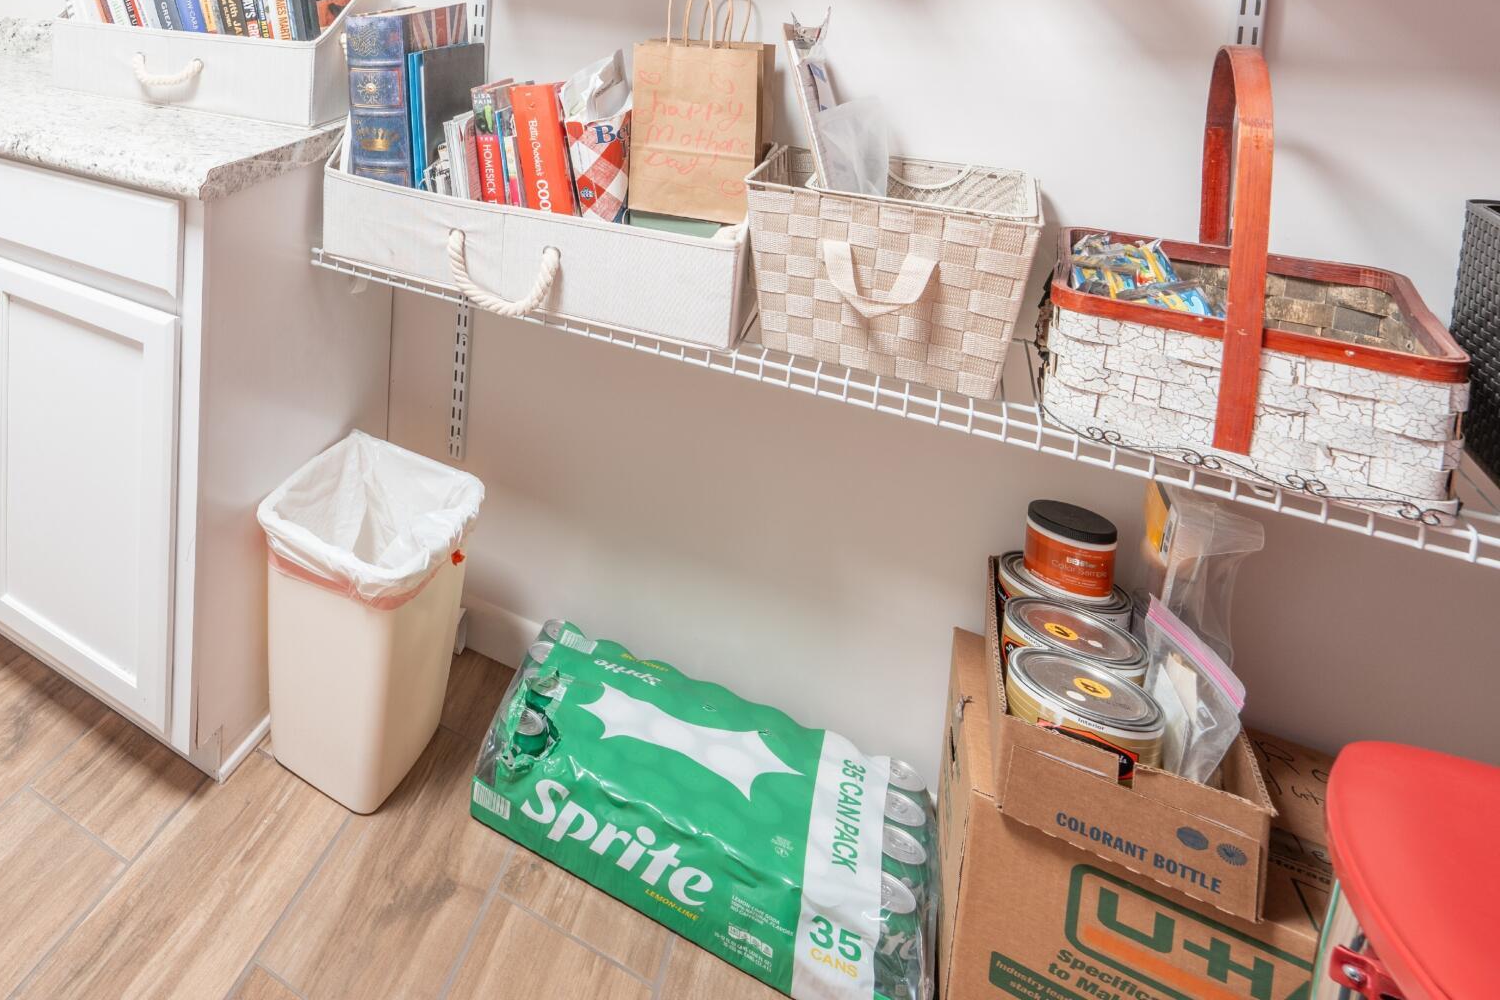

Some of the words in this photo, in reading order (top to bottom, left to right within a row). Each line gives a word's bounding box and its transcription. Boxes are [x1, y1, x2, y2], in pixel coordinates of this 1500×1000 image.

[160, 1, 174, 31] GREAT
[483, 144, 497, 195] HOMESICK
[528, 119, 538, 141] Betty
[536, 179, 552, 213] COO
[1051, 559, 1076, 573] Color
[1077, 568, 1108, 578] Sample
[1077, 717, 1105, 732] Interior
[840, 758, 867, 782] 35
[833, 781, 864, 827] CAN
[520, 778, 714, 906] Sprite
[830, 819, 861, 875] PACK
[1056, 812, 1149, 862] COLORANT
[1153, 853, 1223, 894] BOTTLE
[645, 888, 699, 922] LEMON-LIME
[808, 914, 863, 964] 35
[809, 947, 859, 980] CANS
[995, 959, 1046, 991] Industry
[1048, 962, 1071, 982] to
